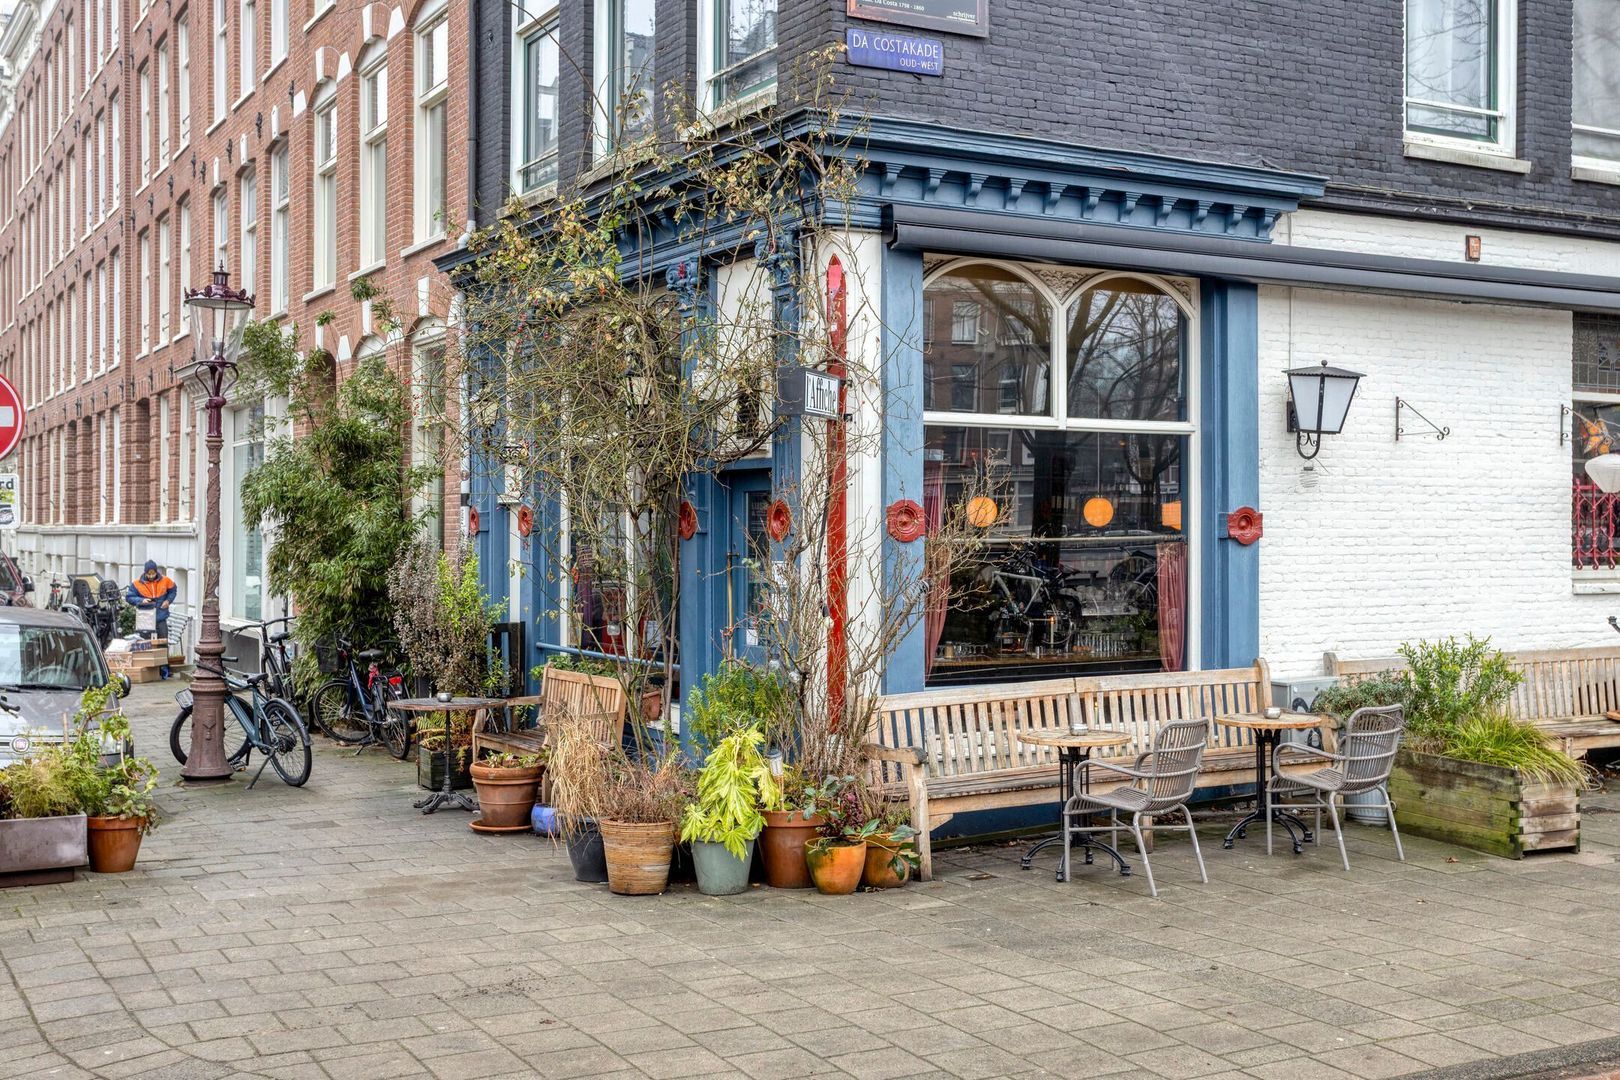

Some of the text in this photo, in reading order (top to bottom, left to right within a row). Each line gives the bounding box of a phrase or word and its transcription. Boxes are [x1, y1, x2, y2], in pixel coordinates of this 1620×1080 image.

[853, 33, 939, 59] DA COSTAKADE
[899, 57, 939, 71] OUD-WEST
